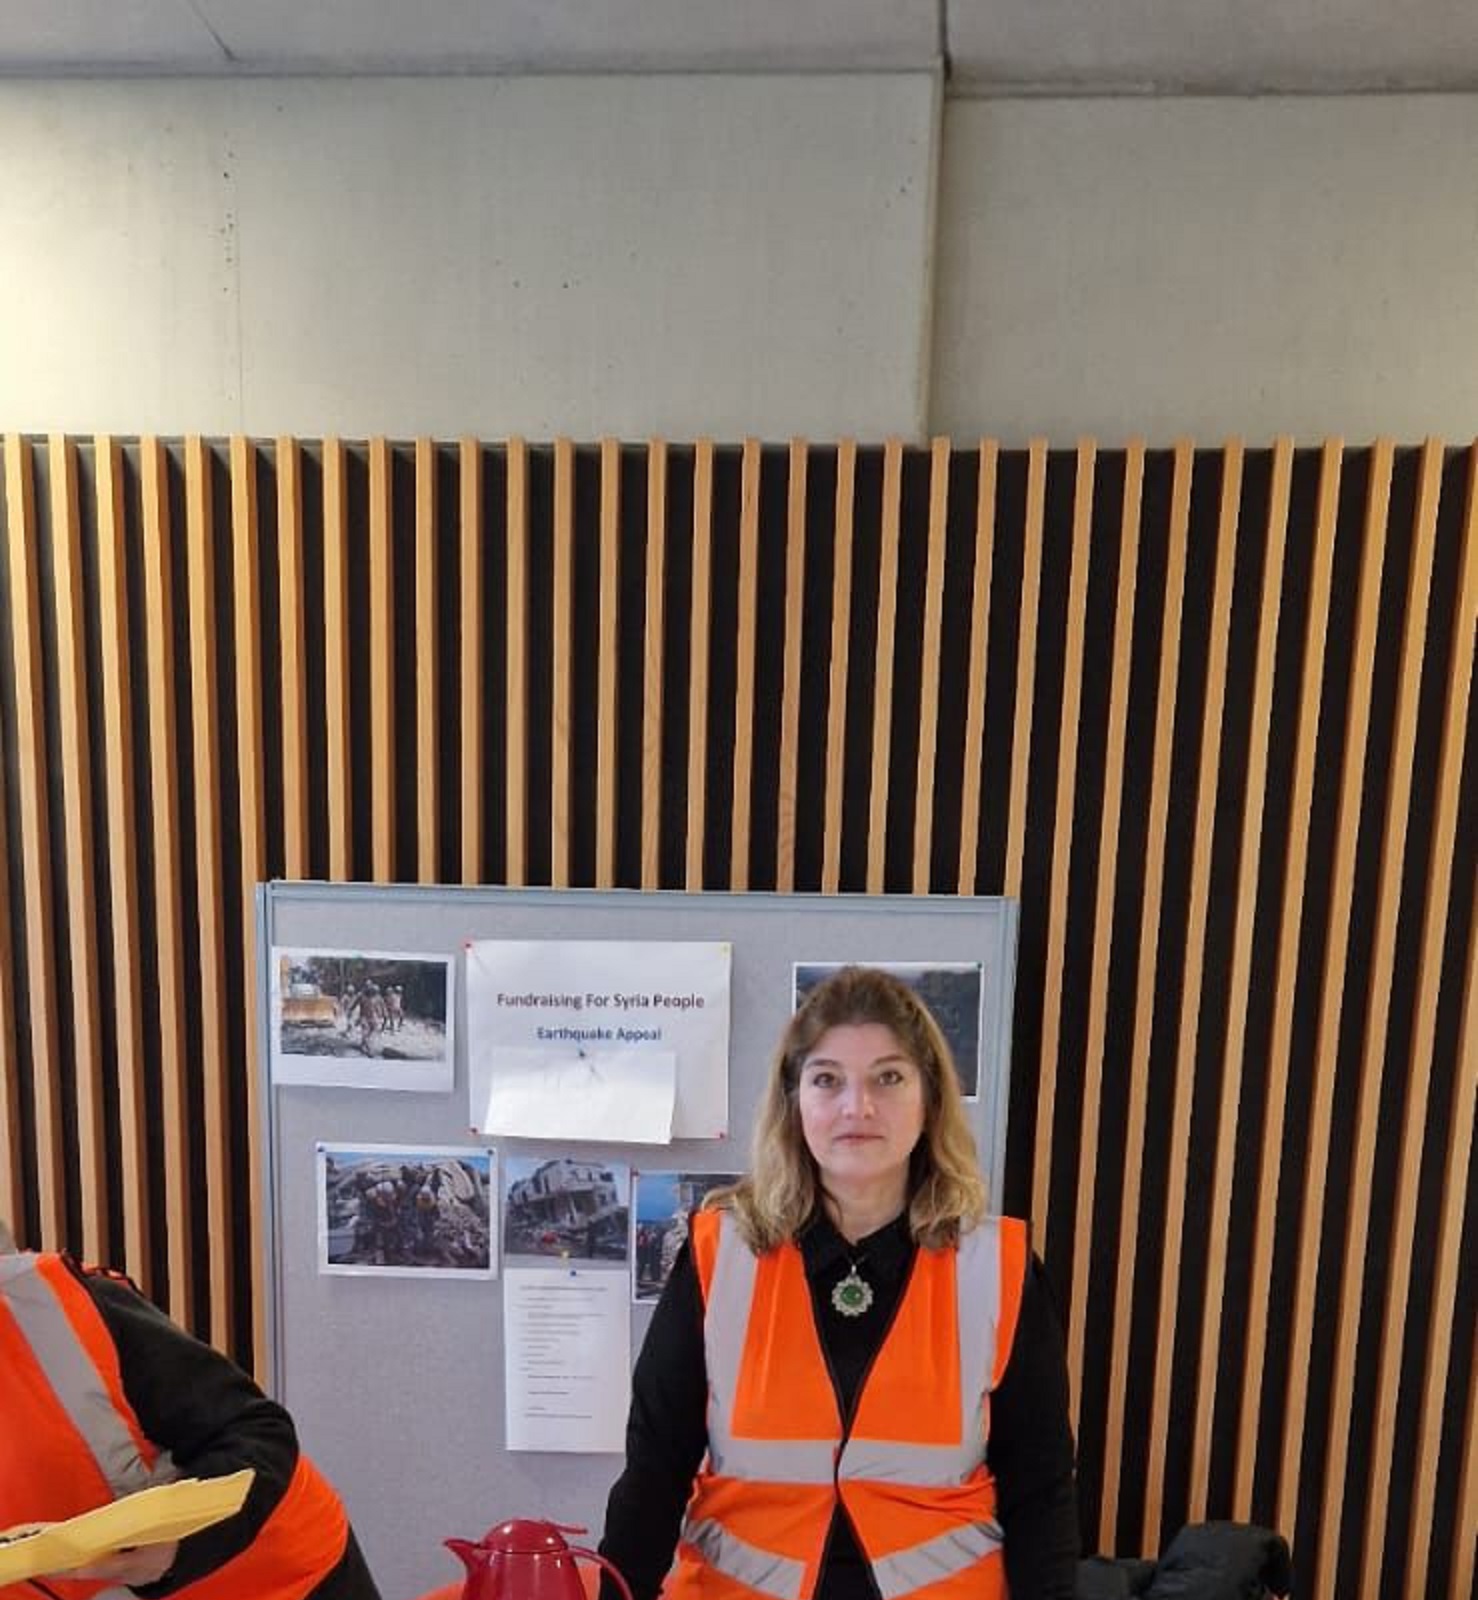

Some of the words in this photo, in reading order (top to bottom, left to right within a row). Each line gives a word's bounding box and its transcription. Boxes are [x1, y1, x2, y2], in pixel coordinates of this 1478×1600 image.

[497, 993, 582, 1011] Fundraising
[586, 994, 610, 1008] For
[614, 994, 649, 1010] Syria
[653, 994, 705, 1009] People
[537, 1026, 612, 1043] Earthquake
[616, 1027, 661, 1042] Appeal
